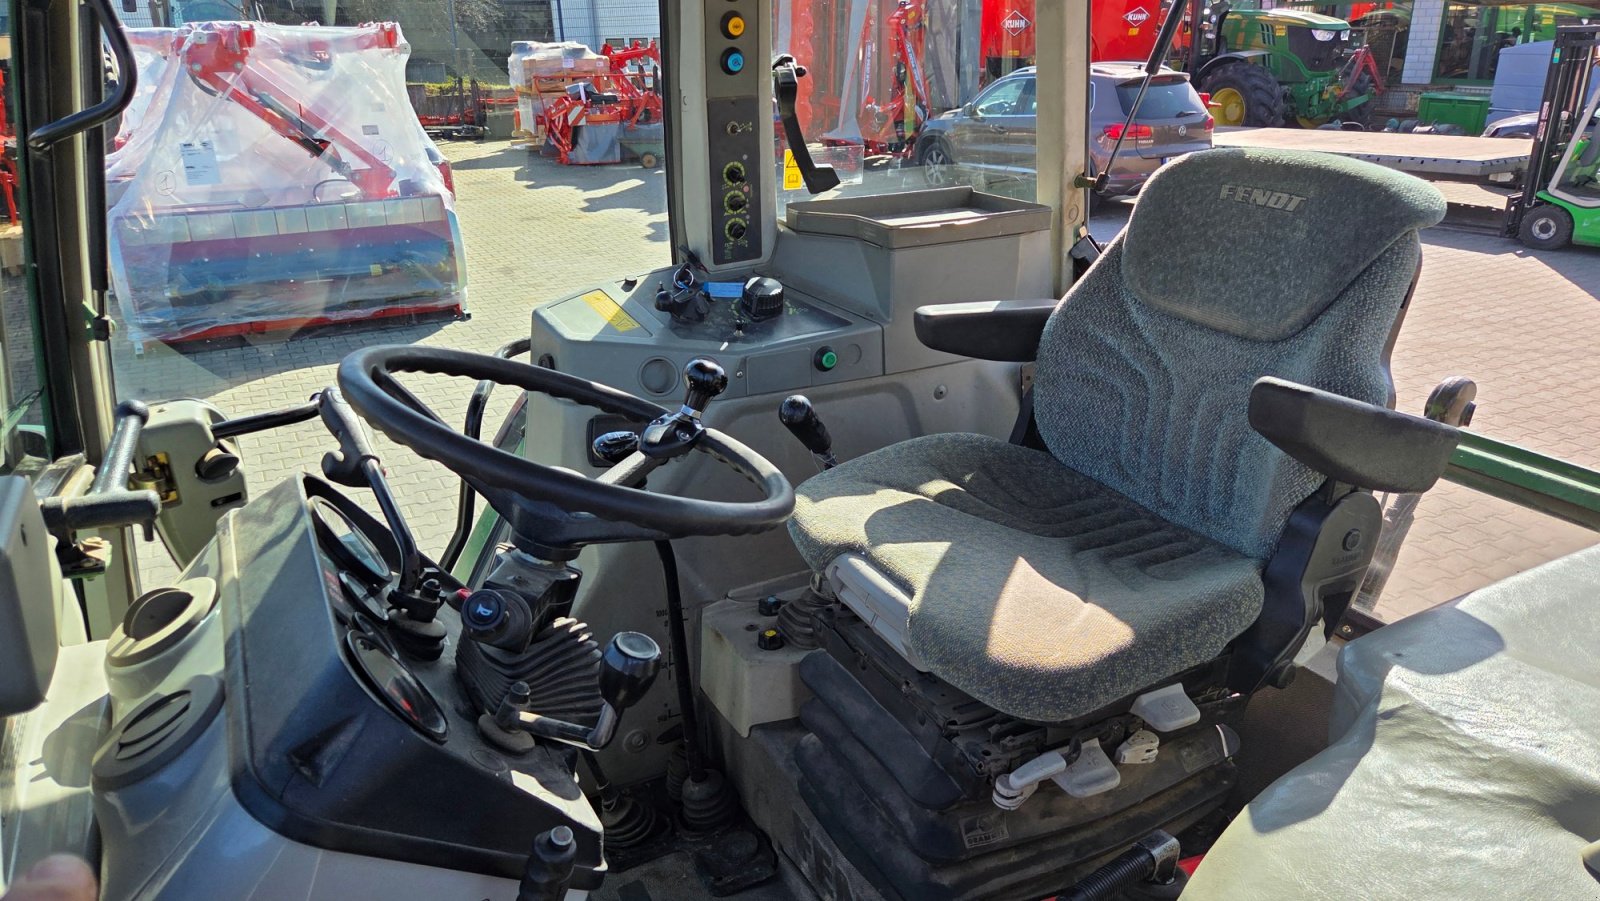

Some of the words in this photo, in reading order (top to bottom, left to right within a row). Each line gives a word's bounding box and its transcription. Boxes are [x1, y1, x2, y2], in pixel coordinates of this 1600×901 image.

[1127, 12, 1148, 21] KUHN
[1004, 19, 1026, 29] KUHN
[1219, 184, 1307, 212] FENDT
